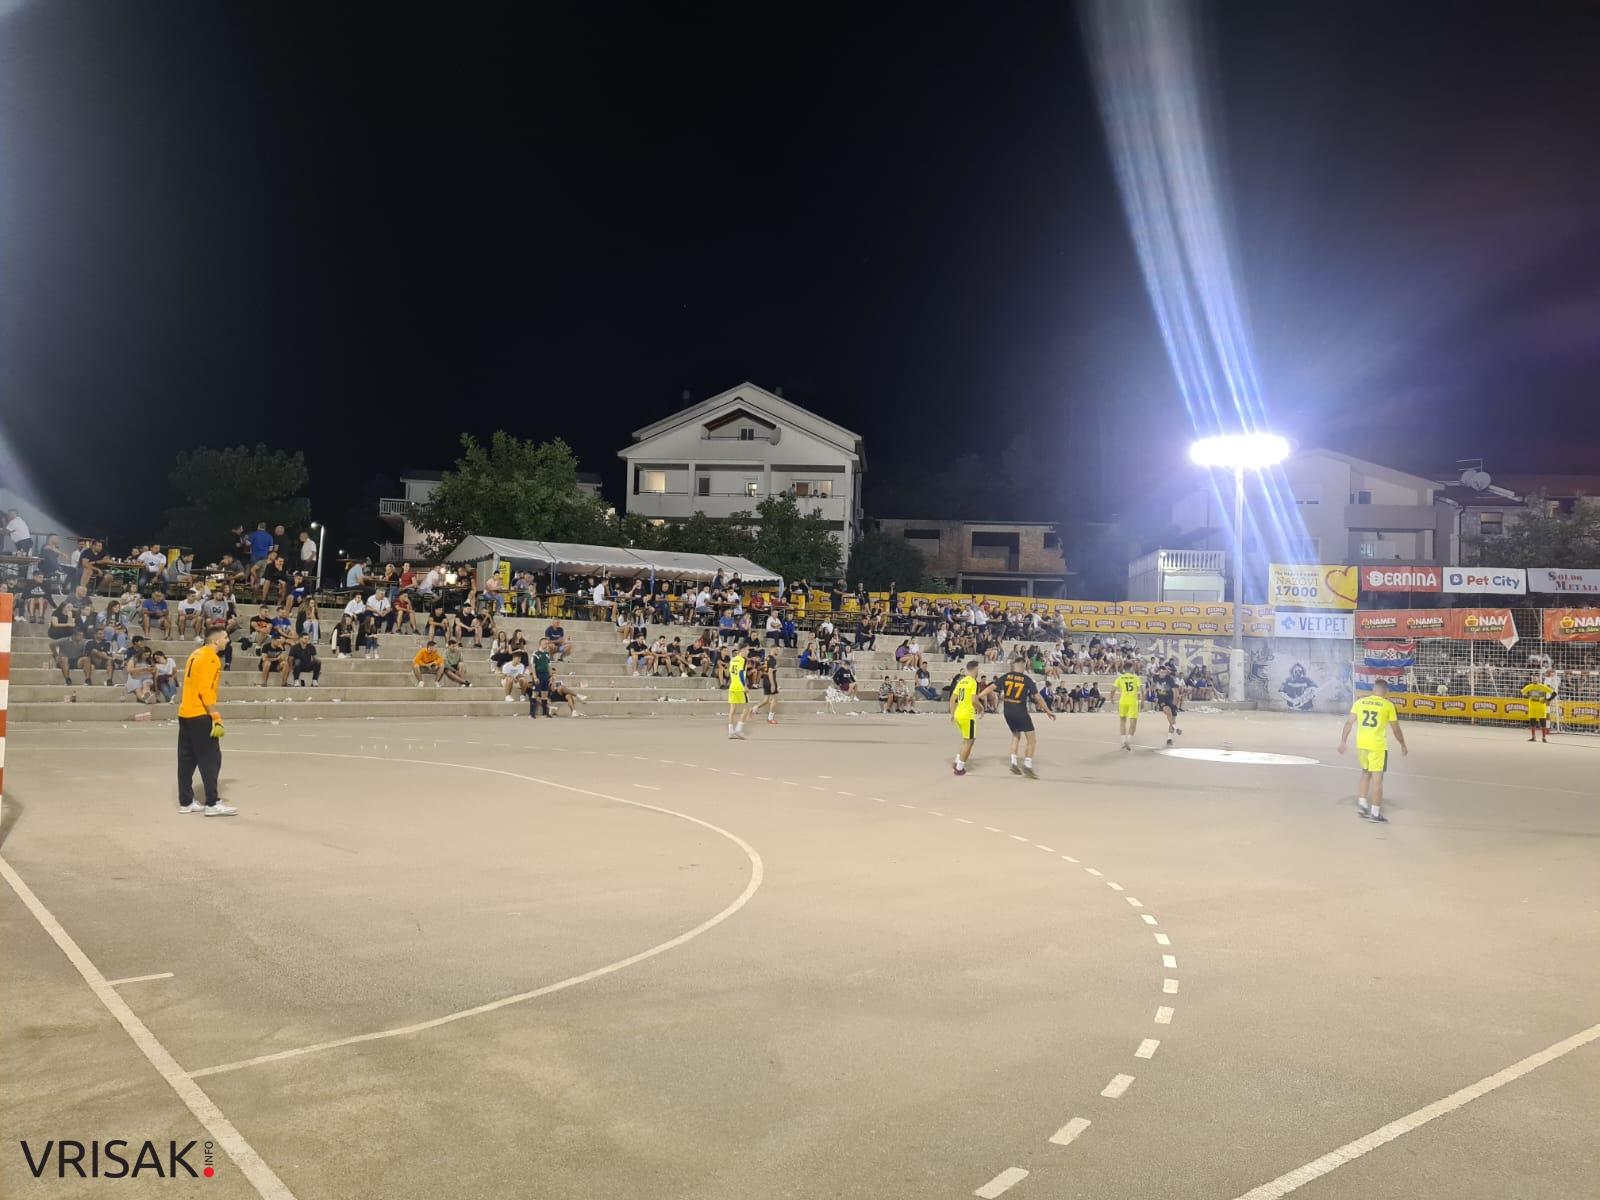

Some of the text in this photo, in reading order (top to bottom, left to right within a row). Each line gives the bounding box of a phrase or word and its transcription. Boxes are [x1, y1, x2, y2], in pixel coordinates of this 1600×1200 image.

[1467, 575, 1520, 589] Pet City
[1276, 586, 1318, 598] 17000
[1299, 616, 1347, 632] VET PET
[1369, 617, 1396, 625] NAMEX
[1415, 616, 1443, 625] NAMEX
[1004, 681, 1025, 700] 77
[1125, 681, 1134, 692] 15
[1362, 709, 1378, 727] 23
